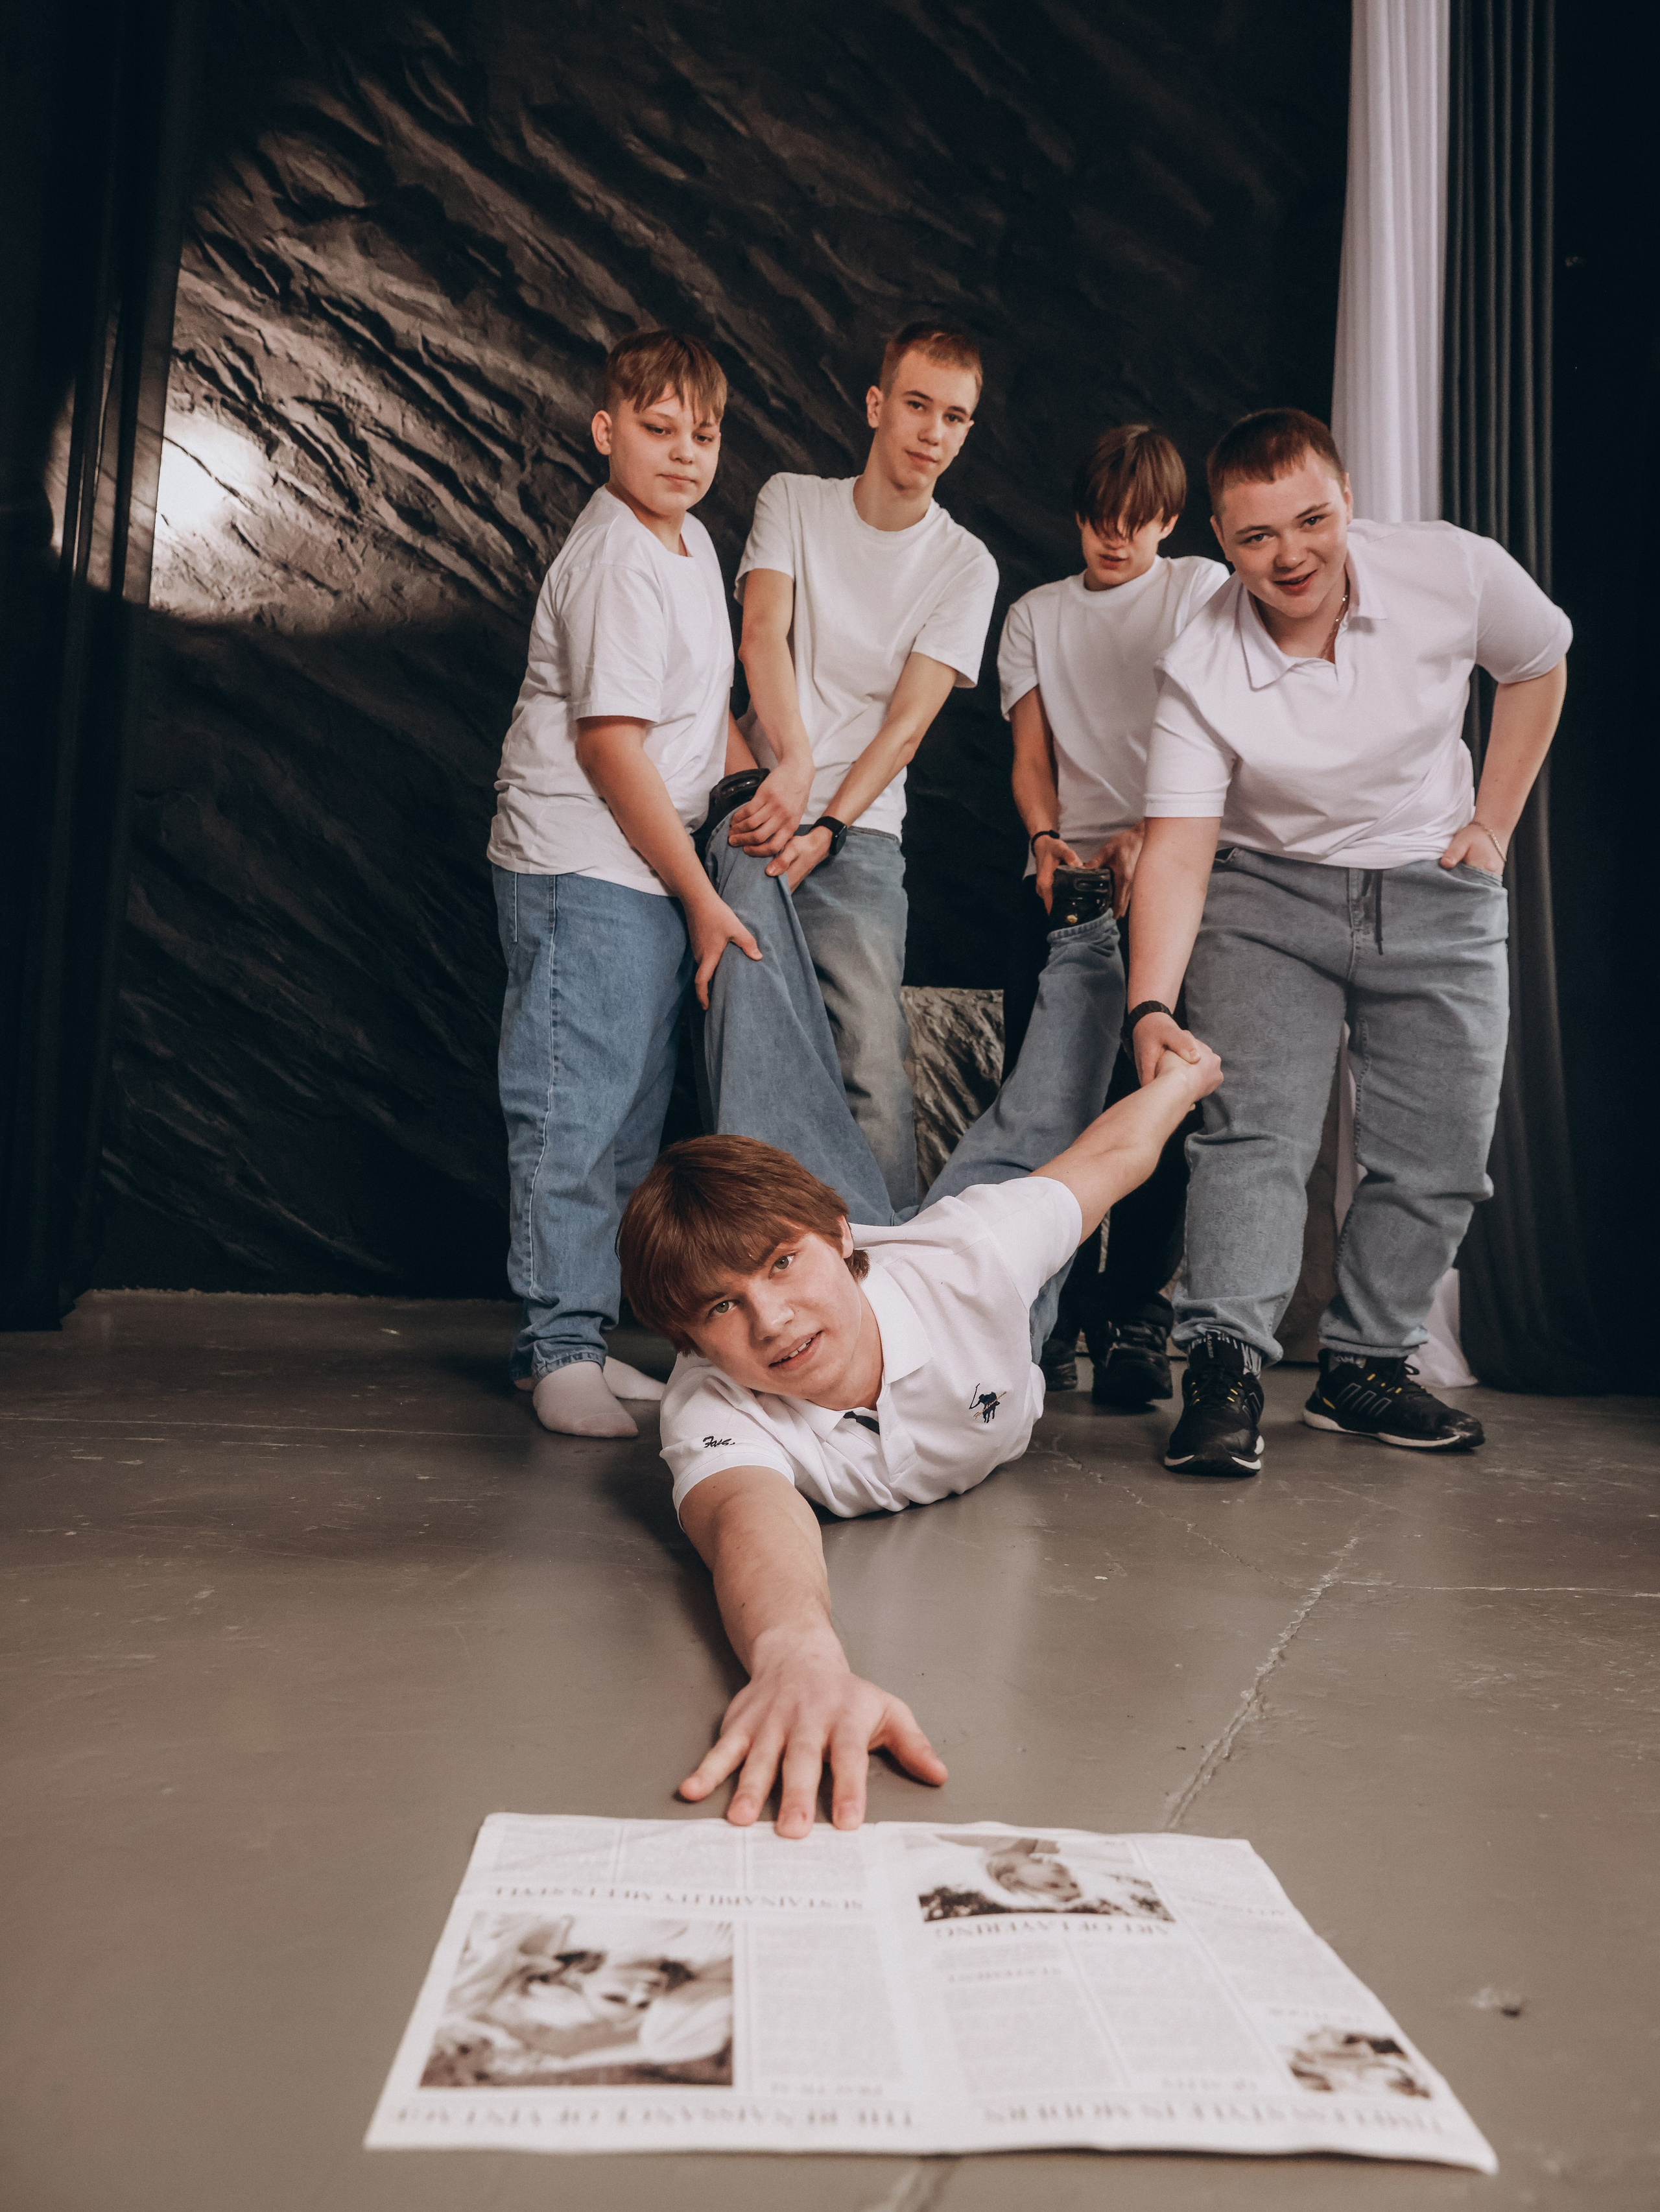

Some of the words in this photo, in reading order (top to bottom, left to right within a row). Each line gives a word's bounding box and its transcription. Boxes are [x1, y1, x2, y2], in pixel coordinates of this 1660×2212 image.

[493, 1886, 565, 1898] STYLE
[571, 1886, 652, 1902] MEETS
[663, 1892, 864, 1910] SUSTAINABILITY
[934, 1920, 1071, 1938] LAYERING
[1077, 1921, 1113, 1933] OF
[1122, 1923, 1170, 1936] ART
[392, 2104, 543, 2127] VINTAGE
[554, 2104, 600, 2126] OF
[611, 2104, 839, 2127] RENAISSANCE
[857, 2108, 915, 2128] THE
[1139, 2103, 1176, 2123] IN
